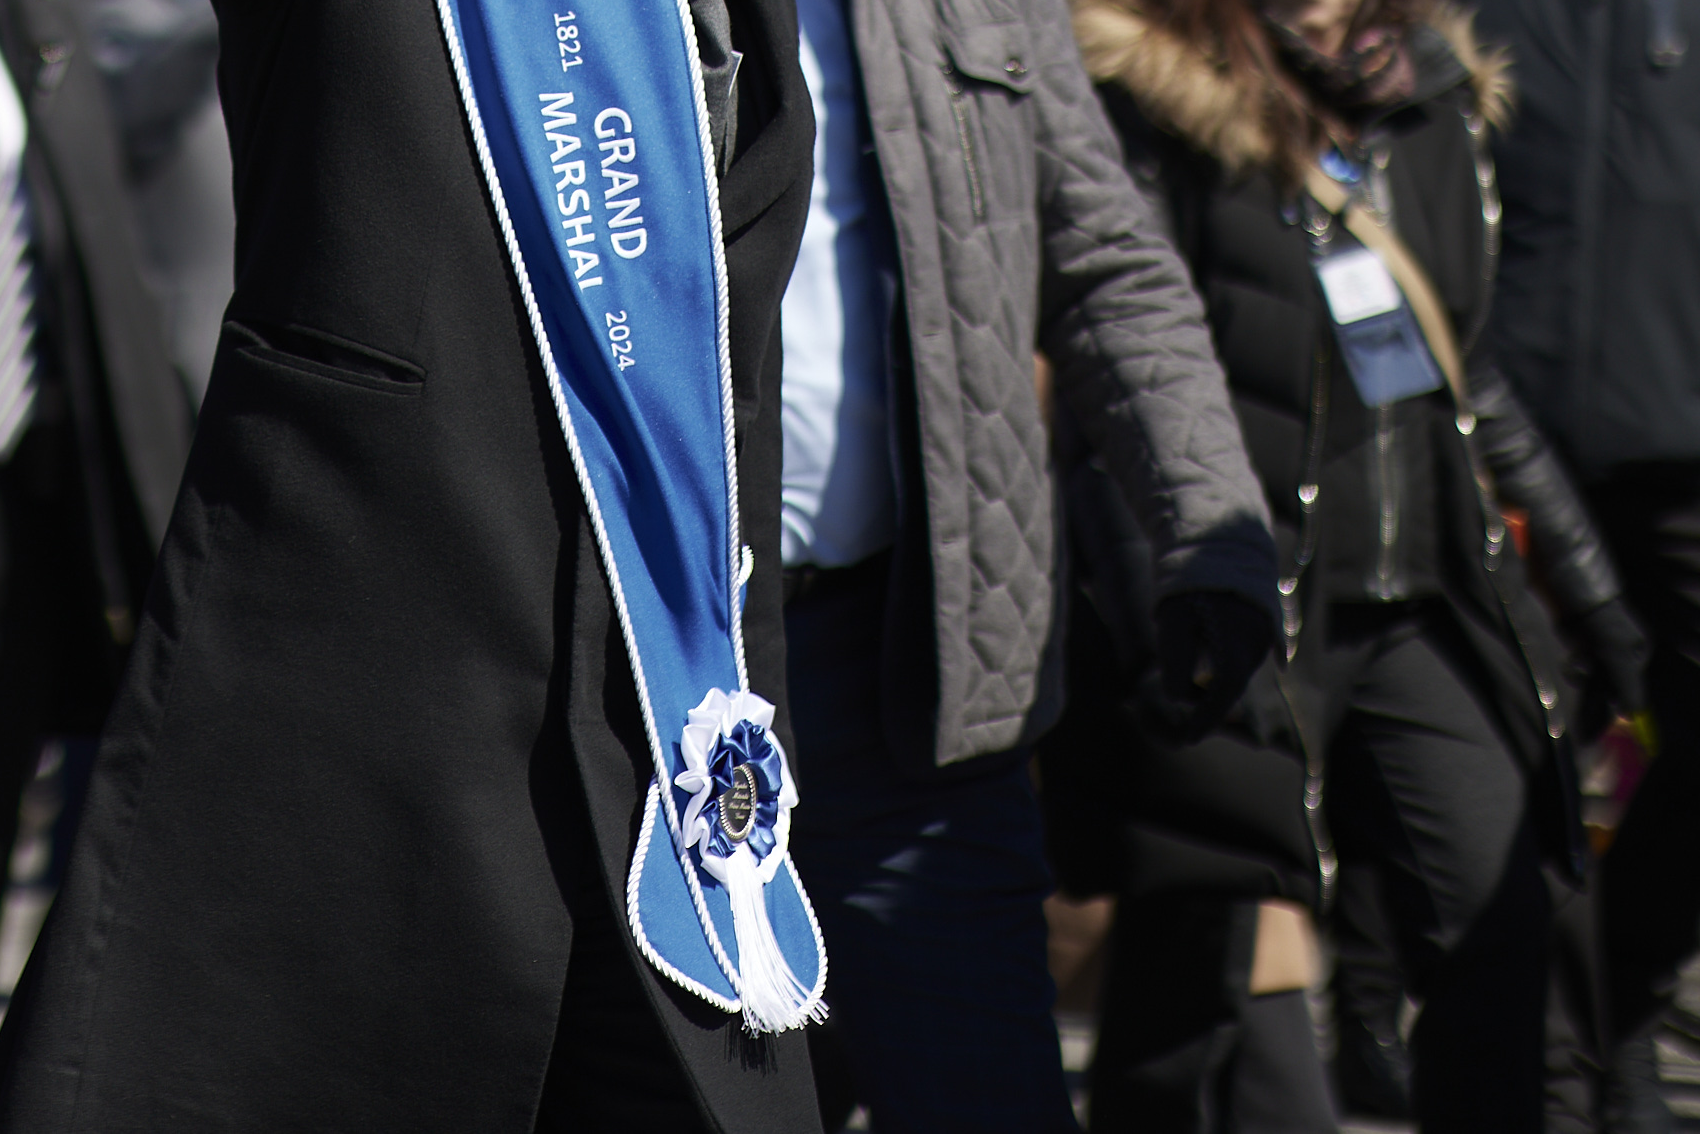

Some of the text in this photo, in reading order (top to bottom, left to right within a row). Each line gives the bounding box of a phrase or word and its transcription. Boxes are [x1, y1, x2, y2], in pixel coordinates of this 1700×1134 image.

[553, 10, 584, 73] 1821
[594, 107, 648, 260] GRAND
[605, 310, 636, 372] 2024
